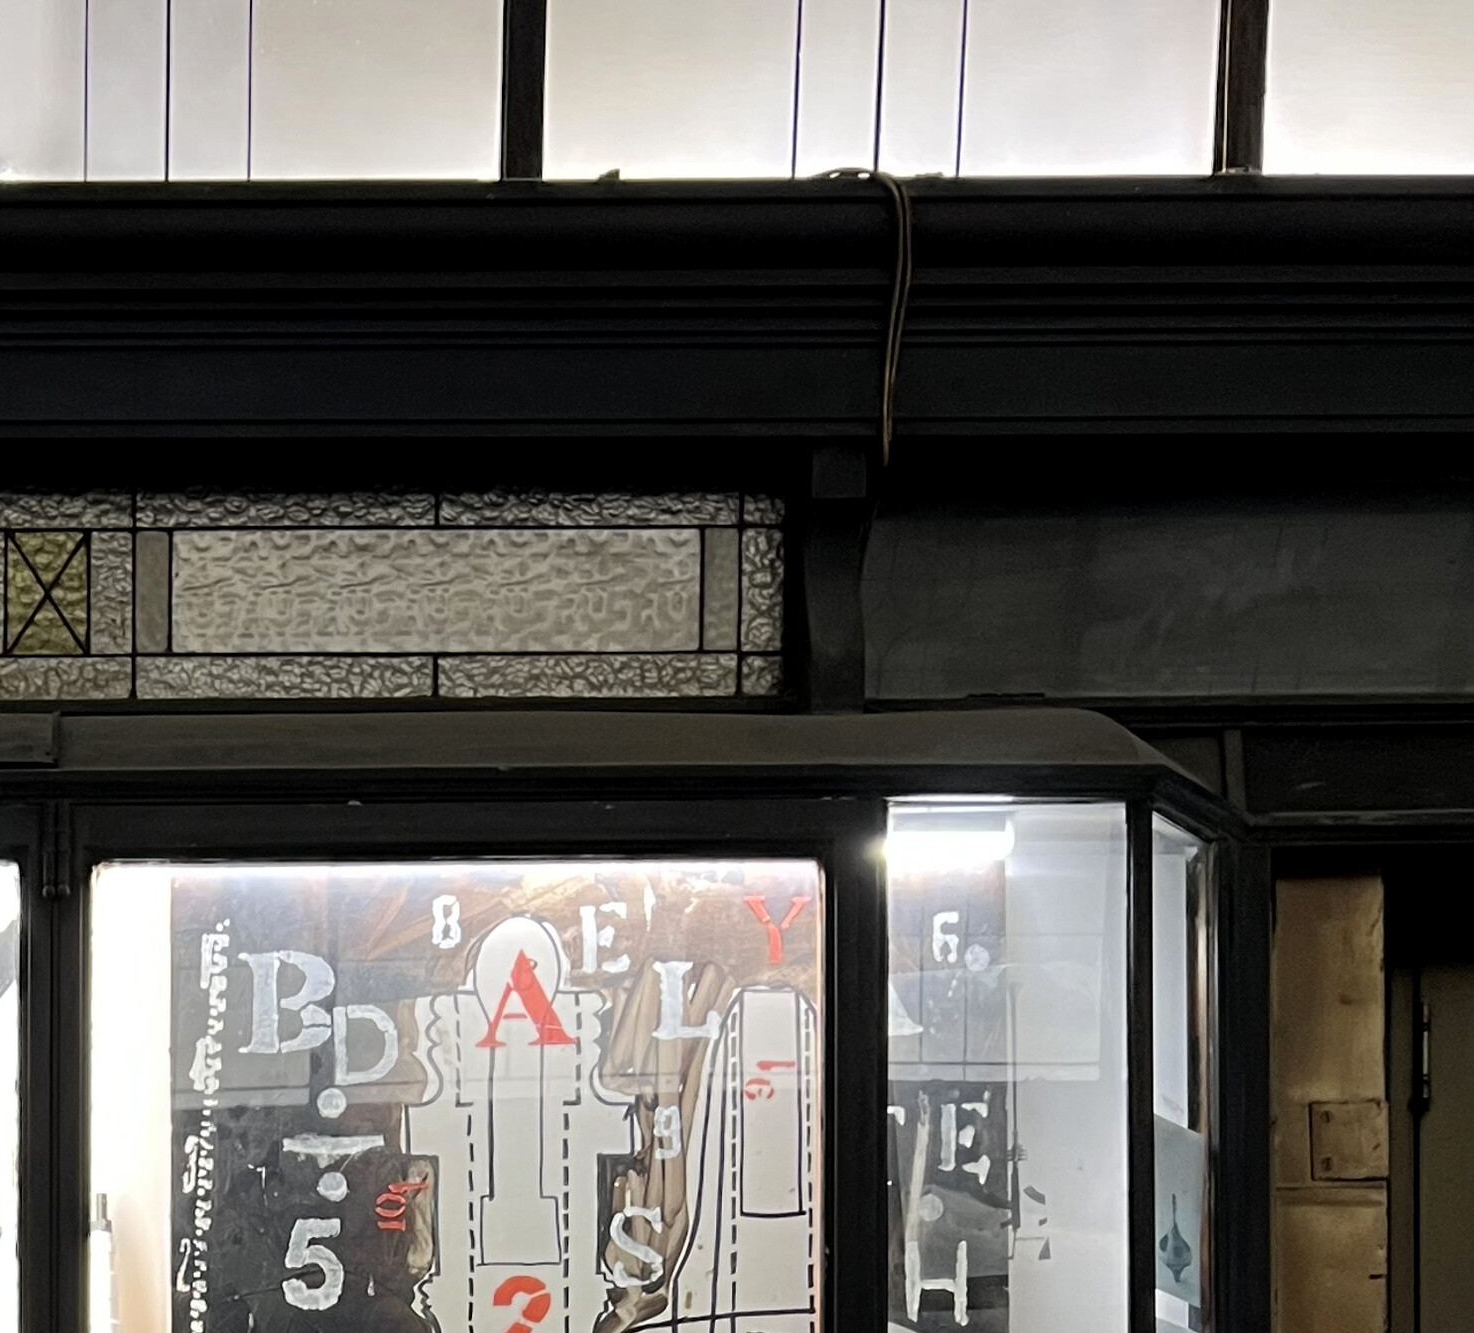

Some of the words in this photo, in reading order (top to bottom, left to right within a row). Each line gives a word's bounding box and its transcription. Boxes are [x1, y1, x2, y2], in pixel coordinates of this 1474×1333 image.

[745, 895, 812, 966] Y
[475, 949, 578, 1048] A
[652, 961, 721, 1041] L
[282, 1216, 345, 1311] 5
[609, 1205, 664, 1289] S
[904, 1240, 969, 1327] H
